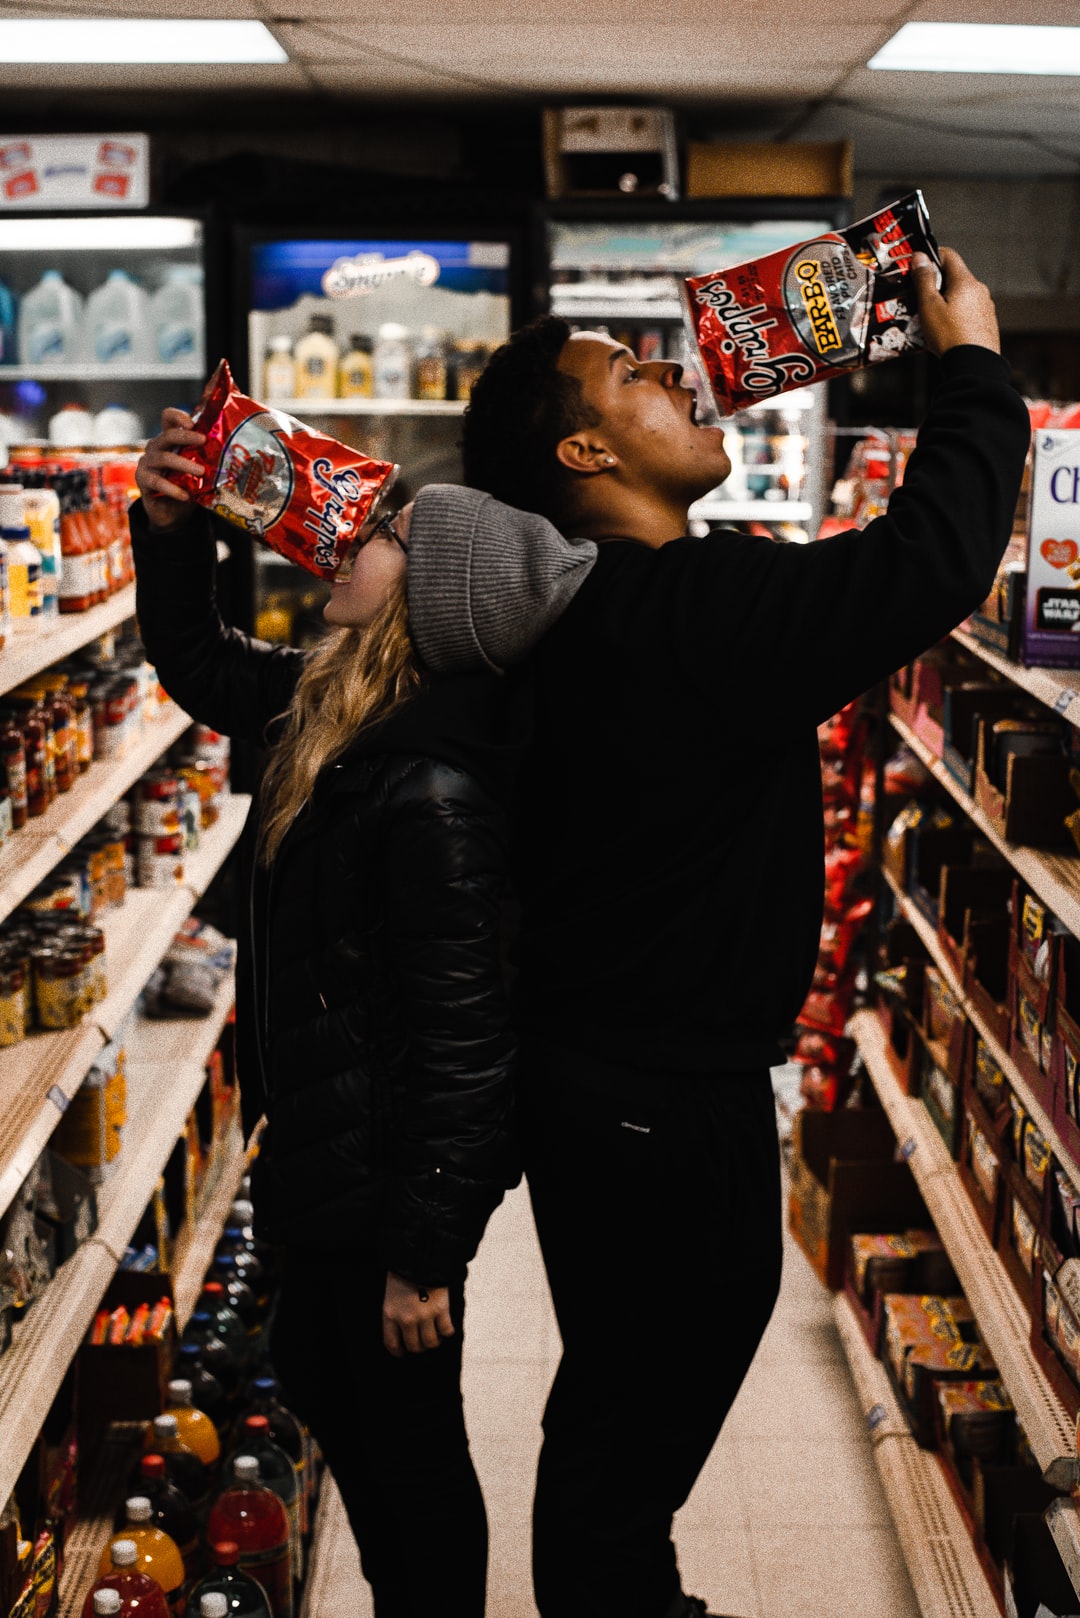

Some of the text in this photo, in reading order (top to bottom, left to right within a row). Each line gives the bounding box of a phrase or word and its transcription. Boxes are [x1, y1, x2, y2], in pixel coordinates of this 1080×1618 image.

[822, 261, 847, 321] FLAVORED
[833, 256, 851, 302] POTATO
[841, 249, 858, 280] CHIPS
[695, 280, 815, 398] Grippo's
[795, 260, 842, 354] BAR-BQ
[303, 457, 361, 569] Grippo's
